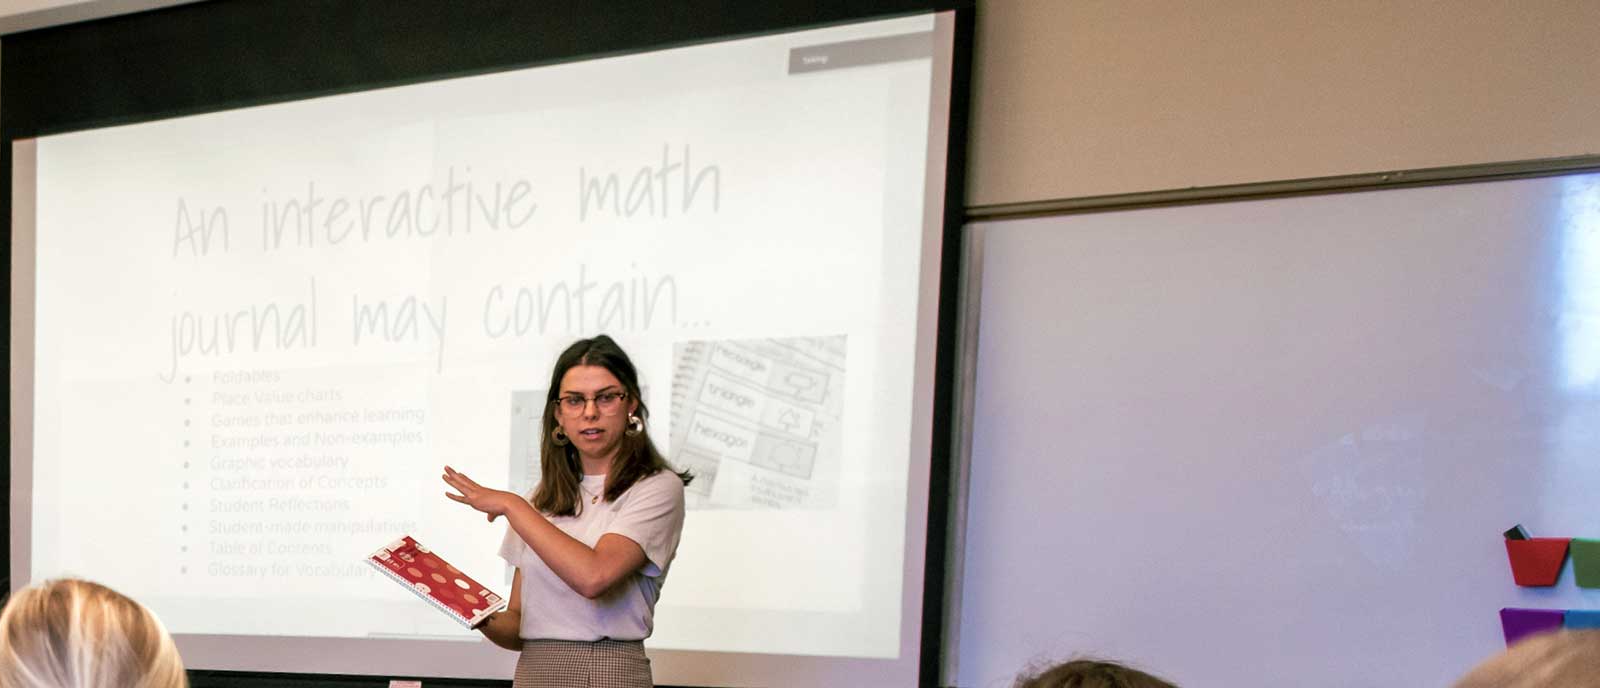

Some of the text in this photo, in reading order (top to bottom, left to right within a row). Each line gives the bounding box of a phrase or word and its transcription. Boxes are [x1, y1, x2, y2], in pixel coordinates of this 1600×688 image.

[173, 142, 722, 259] An interactive math
[159, 262, 712, 384] journal may contain...
[255, 390, 295, 405] Value
[297, 388, 343, 403] charts
[211, 407, 425, 428] Games that enhance learning
[211, 429, 423, 452] Examples and Non-examples
[269, 454, 349, 471] vocabulary
[299, 475, 314, 490] of
[317, 473, 388, 491] Concepts
[210, 497, 350, 513] Student Reflections
[209, 542, 245, 556] Table
[249, 542, 264, 556] of
[208, 563, 262, 580] Glossary
[271, 563, 290, 577] for
